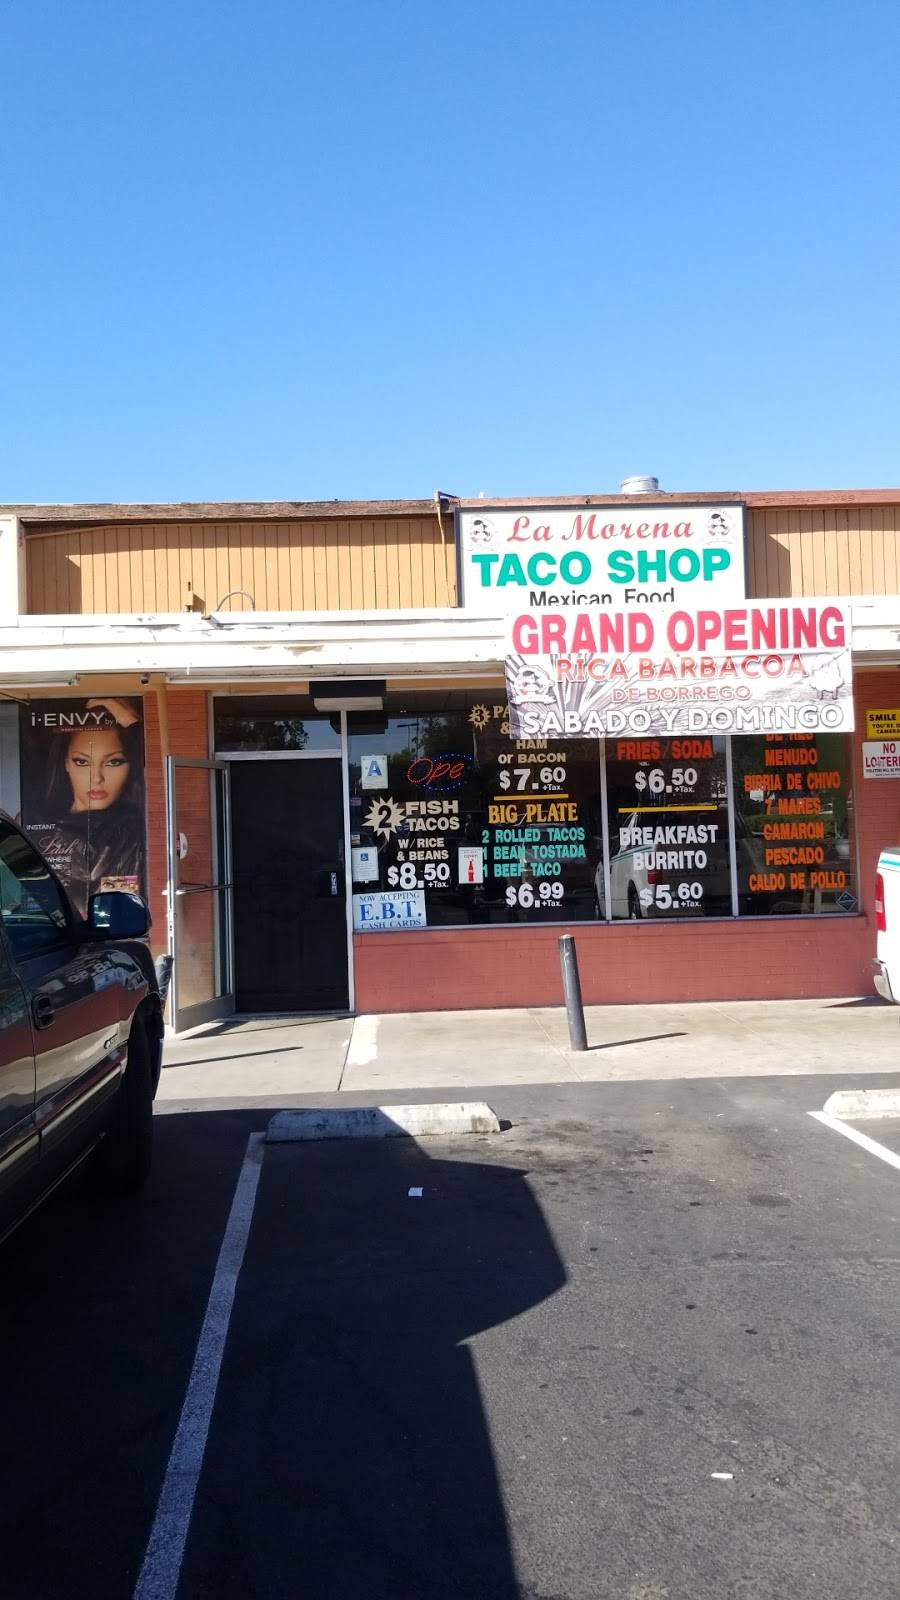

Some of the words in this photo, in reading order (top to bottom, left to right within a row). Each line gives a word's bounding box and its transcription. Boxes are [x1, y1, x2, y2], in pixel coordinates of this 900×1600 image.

[507, 515, 553, 542] La
[561, 514, 694, 540] Morena
[472, 551, 592, 587] TACO
[607, 548, 731, 584] SHOP
[530, 590, 612, 606] Mexican
[625, 588, 675, 603] Food
[512, 612, 654, 654] GRAND
[667, 606, 846, 652] OPENING
[556, 657, 630, 682] RICA
[638, 653, 809, 680] BARBACOA
[612, 688, 640, 703] DE
[646, 685, 751, 702] BORREGO
[523, 708, 651, 735] SABADO
[662, 708, 685, 731] Y
[688, 704, 844, 731] DOMINGO
[869, 714, 896, 722] SMILE
[516, 739, 548, 750] HAM
[883, 743, 896, 754] NO
[498, 754, 514, 764] or
[518, 752, 566, 764] BACON
[765, 748, 818, 766] MENUDO
[368, 760, 382, 776] A
[500, 766, 566, 791] $7.60
[635, 768, 698, 794] $6.50
[744, 774, 782, 792] BIRRIA
[787, 773, 802, 790] DE
[807, 771, 840, 790] CHIVO
[378, 804, 392, 828] 2
[405, 800, 459, 816] FISH
[488, 804, 518, 824] BIG
[526, 802, 578, 822] PLATE
[765, 799, 772, 816] 7
[778, 798, 820, 815] MARES
[405, 816, 460, 832] TACOS
[764, 822, 824, 840] CAMARON
[482, 830, 490, 844] 2
[496, 828, 540, 843] ROLLED
[548, 827, 586, 842] TACOS
[620, 824, 718, 846] BREAKFAST
[396, 850, 405, 862] &
[408, 850, 449, 861] BEANS
[494, 846, 526, 860] BEAN
[532, 844, 586, 859] TOSTADA
[633, 850, 707, 871] BURRITO
[766, 847, 824, 866] PESCADO
[388, 862, 450, 890] $8.50
[494, 863, 525, 878] BEEF
[530, 862, 561, 876] TACO
[749, 873, 786, 891] CALDO
[790, 872, 805, 890] DE
[810, 871, 846, 888] POLLO
[360, 894, 376, 902] NOW
[380, 891, 420, 900] ACCEPTING
[506, 882, 564, 908] $6.99
[639, 882, 703, 910] $5.60
[360, 900, 422, 921] E.B.T.
[362, 922, 386, 930] CASH
[390, 920, 422, 928] CARDS
